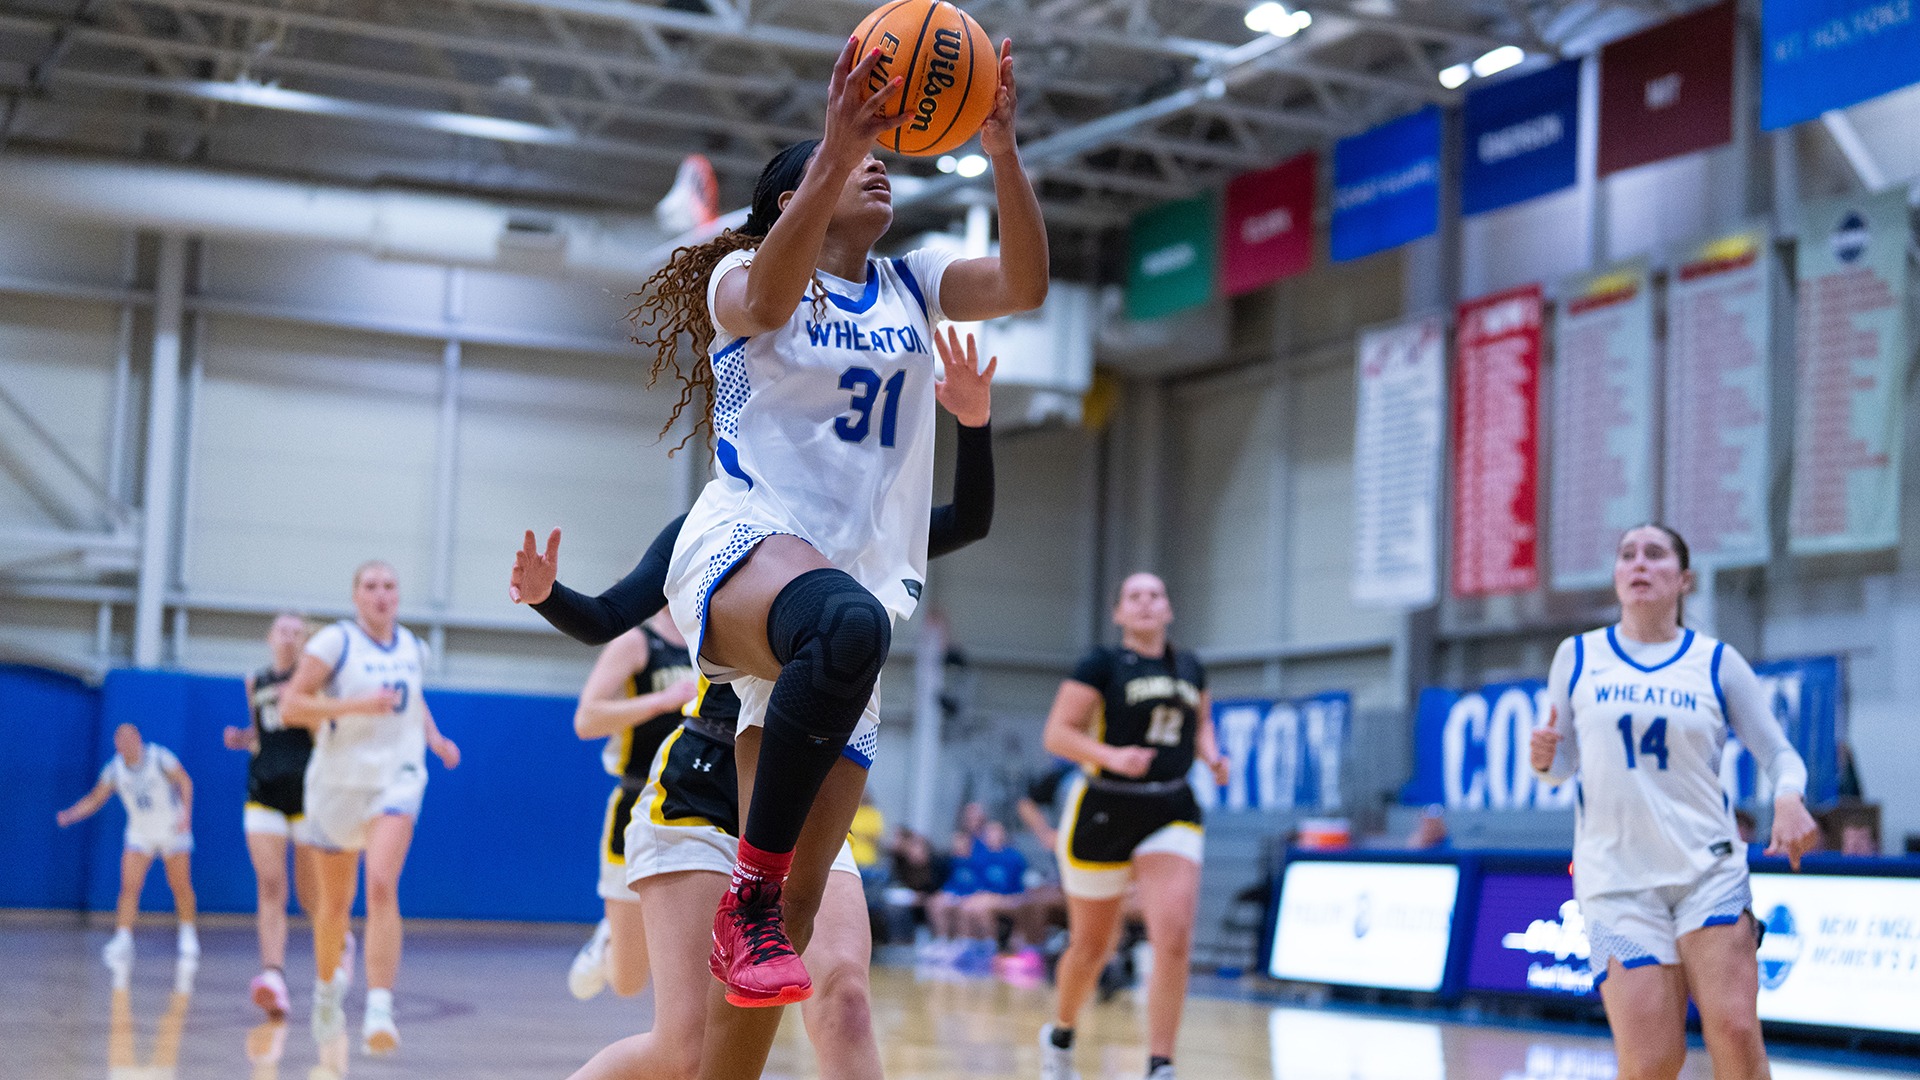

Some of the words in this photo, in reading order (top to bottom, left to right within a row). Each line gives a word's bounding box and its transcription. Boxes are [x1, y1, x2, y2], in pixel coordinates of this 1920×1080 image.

[909, 28, 963, 132] Wilson
[806, 320, 928, 355] WHEATON
[832, 365, 907, 449] 31
[1595, 684, 1697, 711] WHEATON
[1617, 713, 1669, 771] 14
